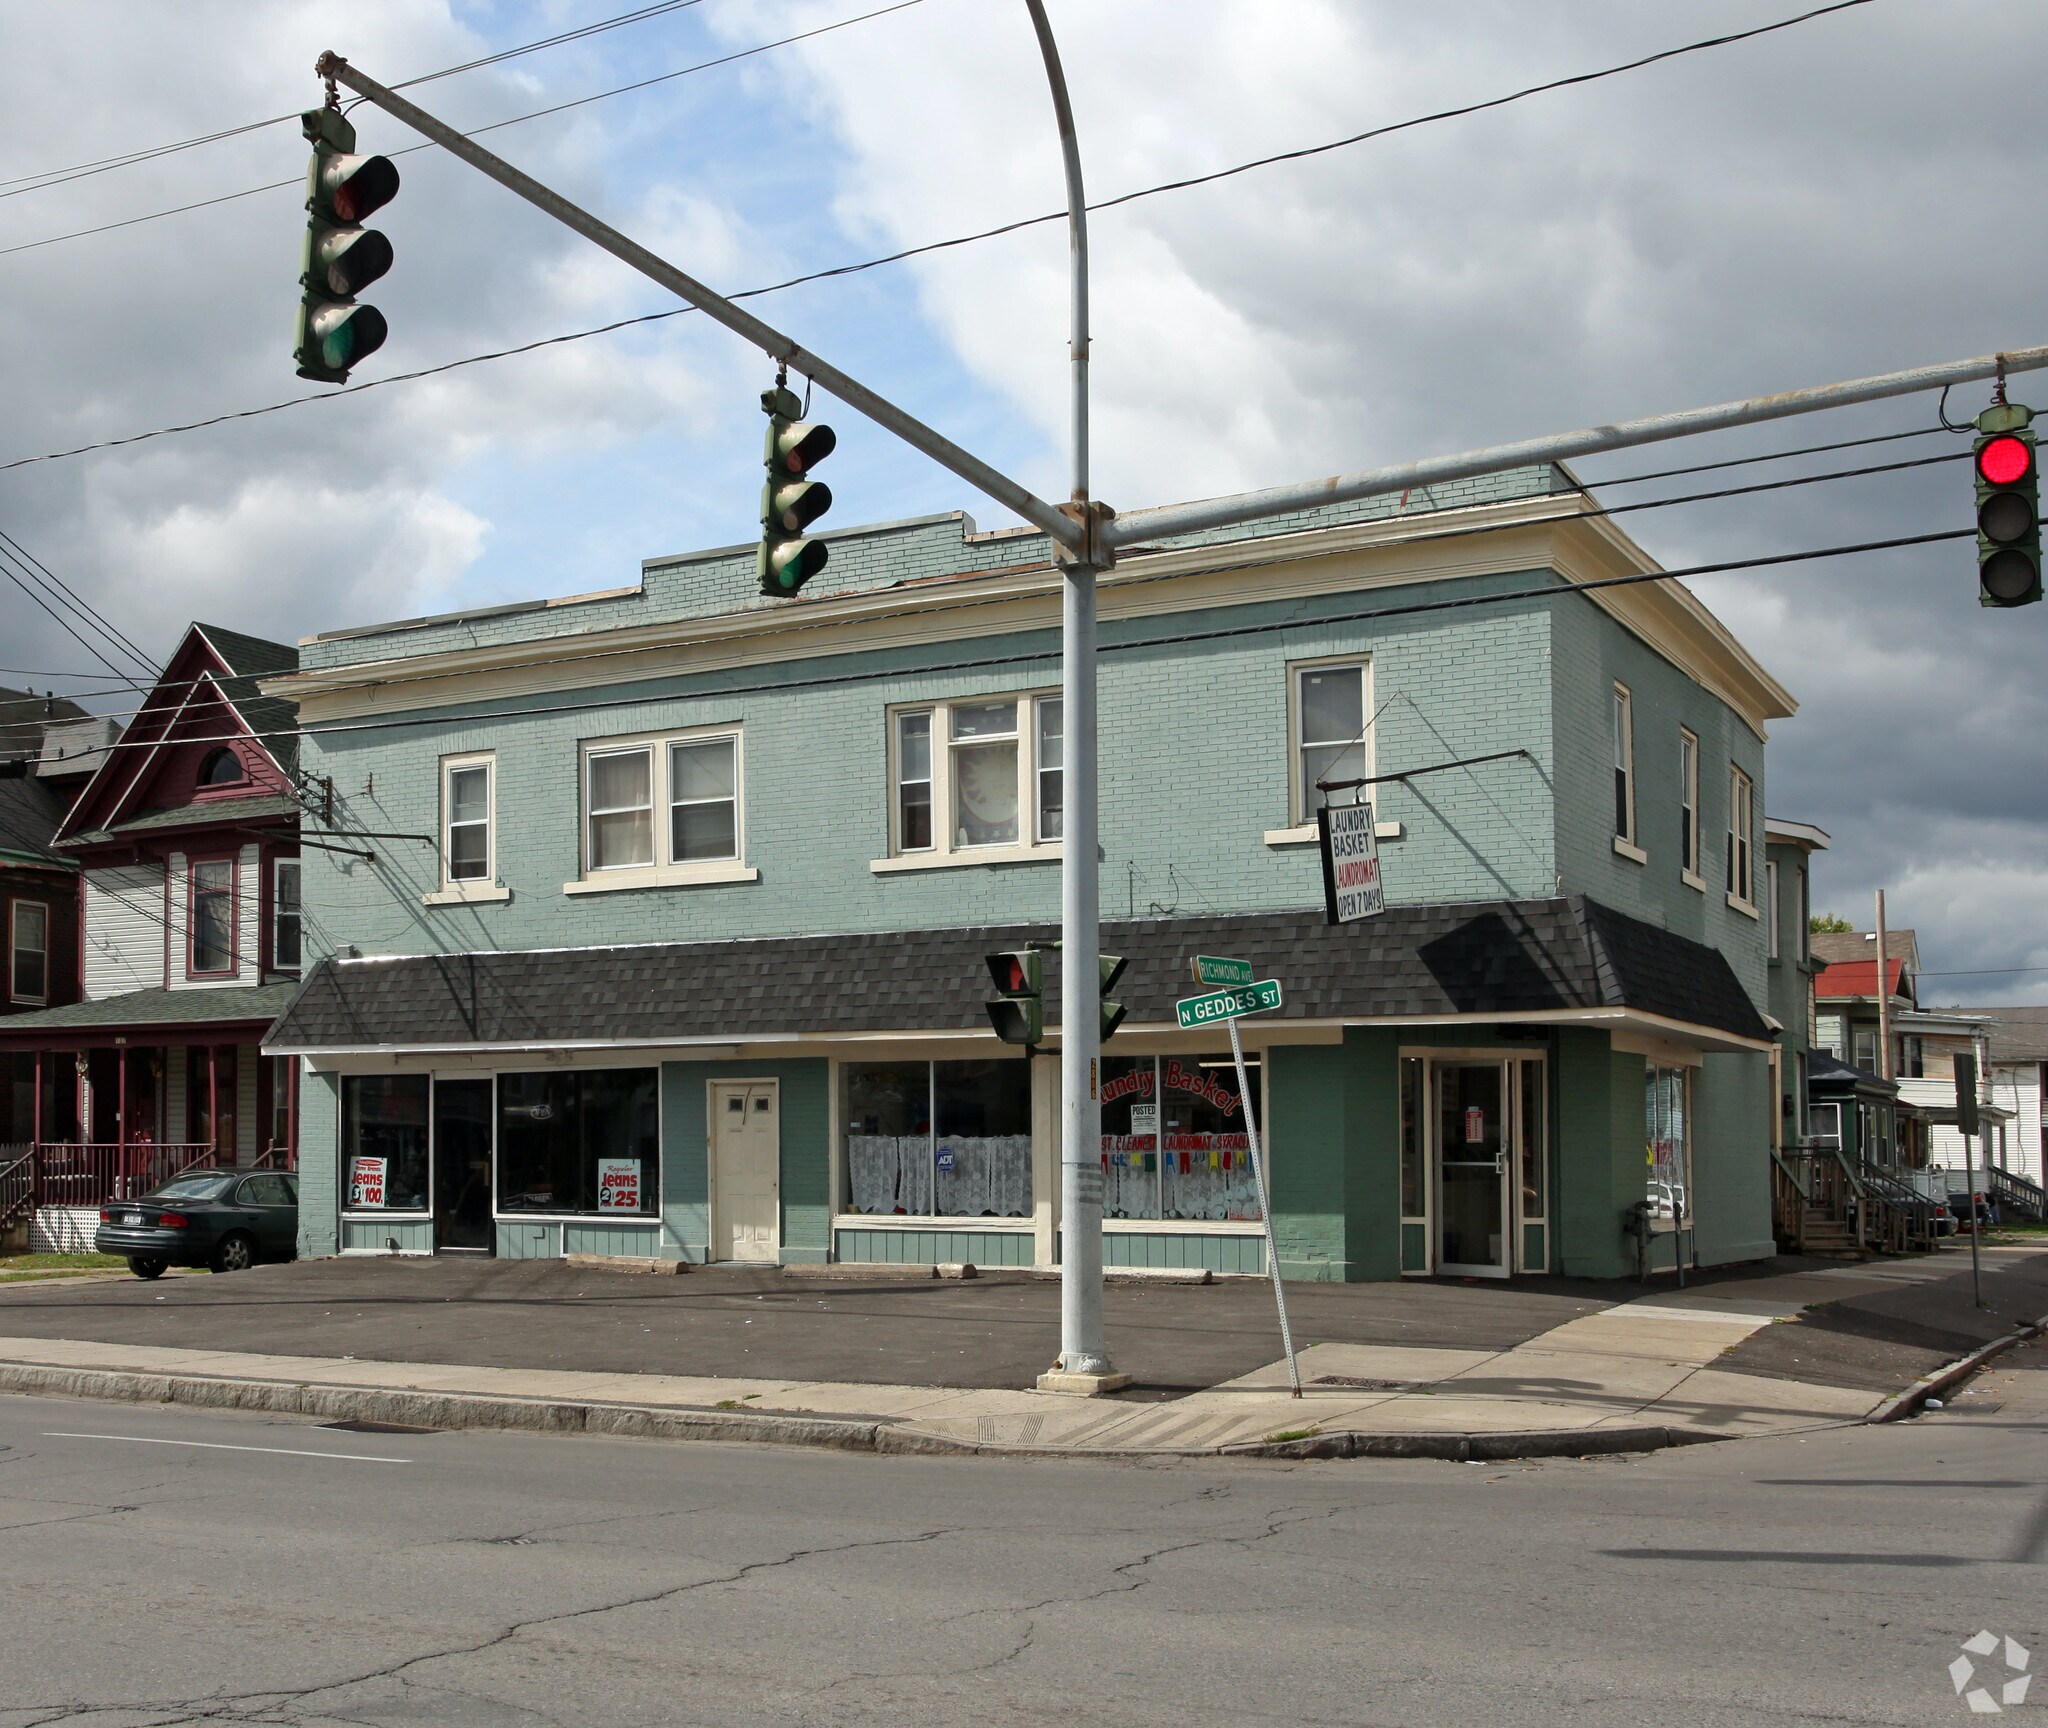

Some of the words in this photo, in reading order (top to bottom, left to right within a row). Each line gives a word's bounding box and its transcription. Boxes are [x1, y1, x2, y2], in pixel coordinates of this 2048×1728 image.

[1329, 808, 1371, 834] LAUNDRY
[1333, 832, 1369, 857] BASKET
[1335, 858, 1378, 890] LAUNDROMAT
[1339, 893, 1356, 917] OPEN
[1357, 892, 1363, 914] 7
[1363, 888, 1382, 912] DAYS
[1201, 962, 1240, 981] RICHMOND
[1241, 970, 1252, 982] AVE
[1181, 1010, 1191, 1023] N
[1194, 991, 1257, 1020] GEDDES
[1261, 990, 1276, 1004] ST
[1101, 1069, 1155, 1105] undry
[1164, 1060, 1243, 1117] Basket
[1132, 1105, 1156, 1115] POSTED
[1217, 1135, 1250, 1150] SYRACU
[939, 1155, 953, 1165] ADT
[351, 1171, 383, 1186] Jeans
[607, 1165, 634, 1174] Regular
[601, 1172, 638, 1188] Jeans
[601, 1189, 610, 1201] 2
